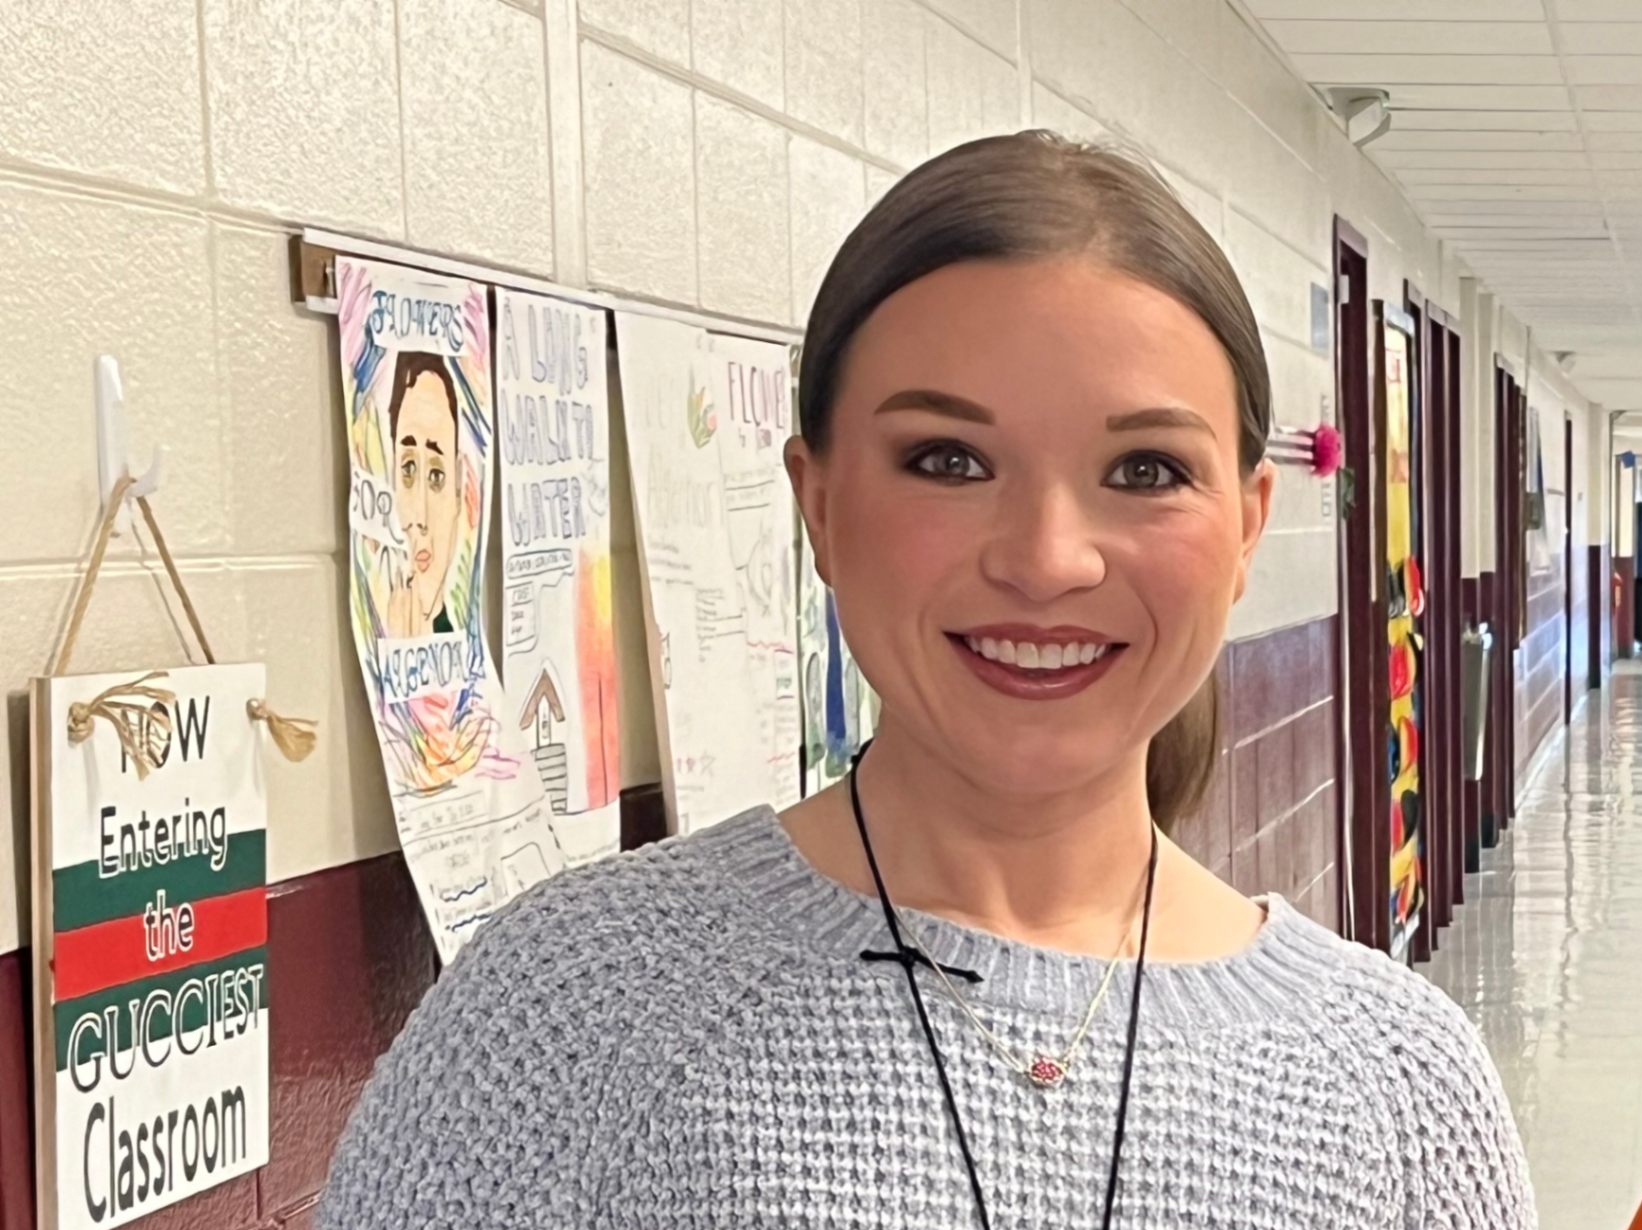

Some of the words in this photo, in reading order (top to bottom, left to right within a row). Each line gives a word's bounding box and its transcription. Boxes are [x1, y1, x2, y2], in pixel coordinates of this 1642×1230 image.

[100, 796, 227, 878] Entering
[143, 890, 195, 962] the
[68, 965, 264, 1093] GUCCIEST
[84, 1084, 247, 1224] Classroom
